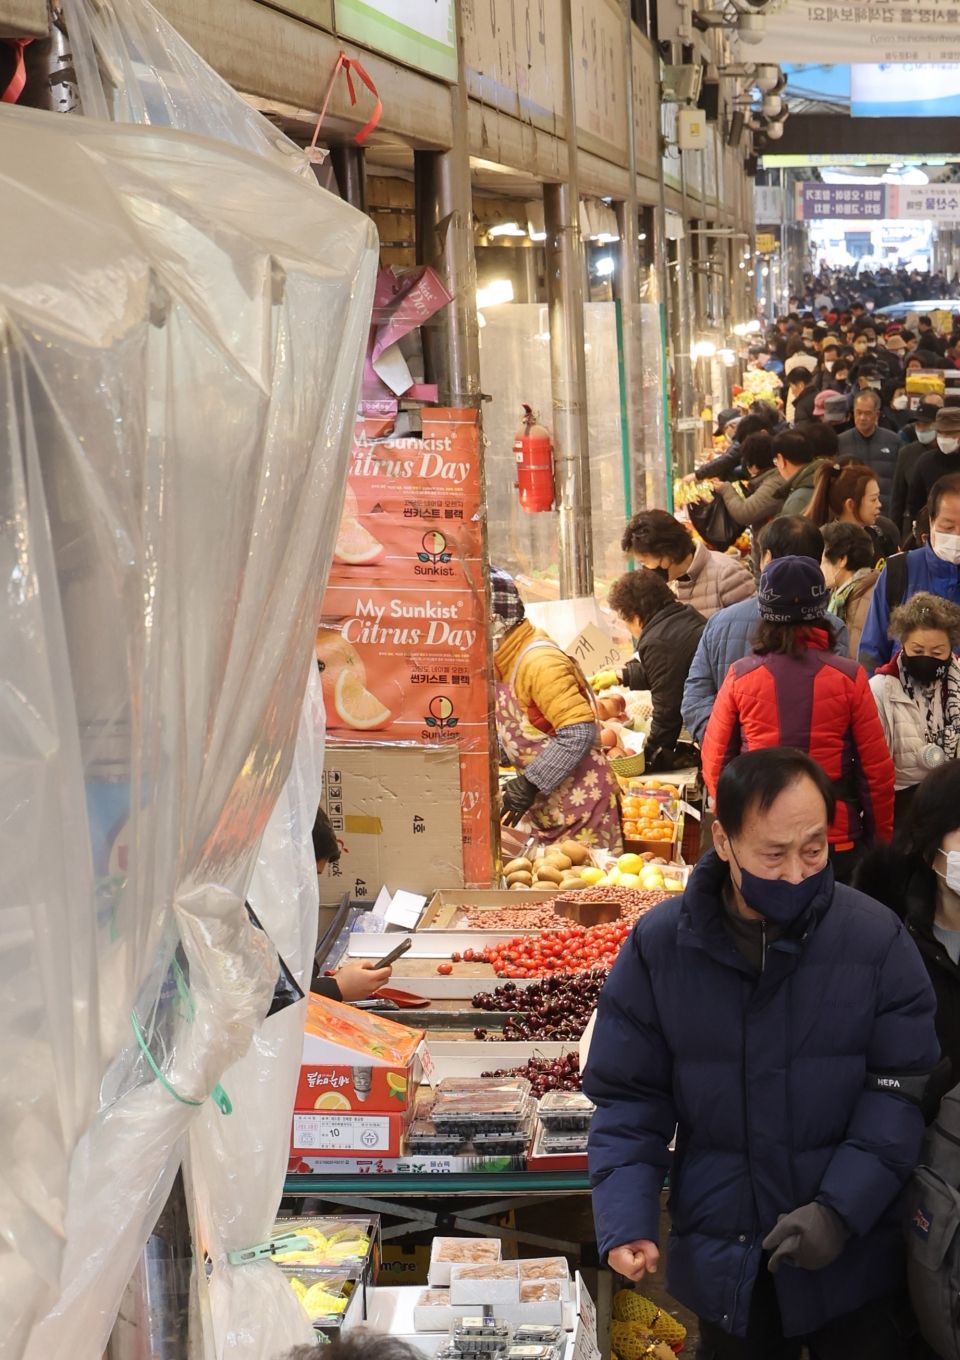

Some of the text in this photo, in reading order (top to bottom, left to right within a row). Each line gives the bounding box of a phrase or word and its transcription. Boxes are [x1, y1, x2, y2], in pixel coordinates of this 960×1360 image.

[349, 447, 471, 484] itrus Day
[403, 508, 464, 519] 썬키스트 블랙
[414, 565, 454, 576] Sunkist
[355, 598, 458, 623] My Sunkist
[341, 618, 477, 651] Citrus Day
[410, 674, 471, 685] 썬키스트 블랙
[421, 729, 461, 740] Sunkist
[413, 814, 426, 834] 4호
[355, 878, 367, 897] 4호
[877, 1078, 901, 1088] NEPA
[329, 1128, 341, 1137] 10
